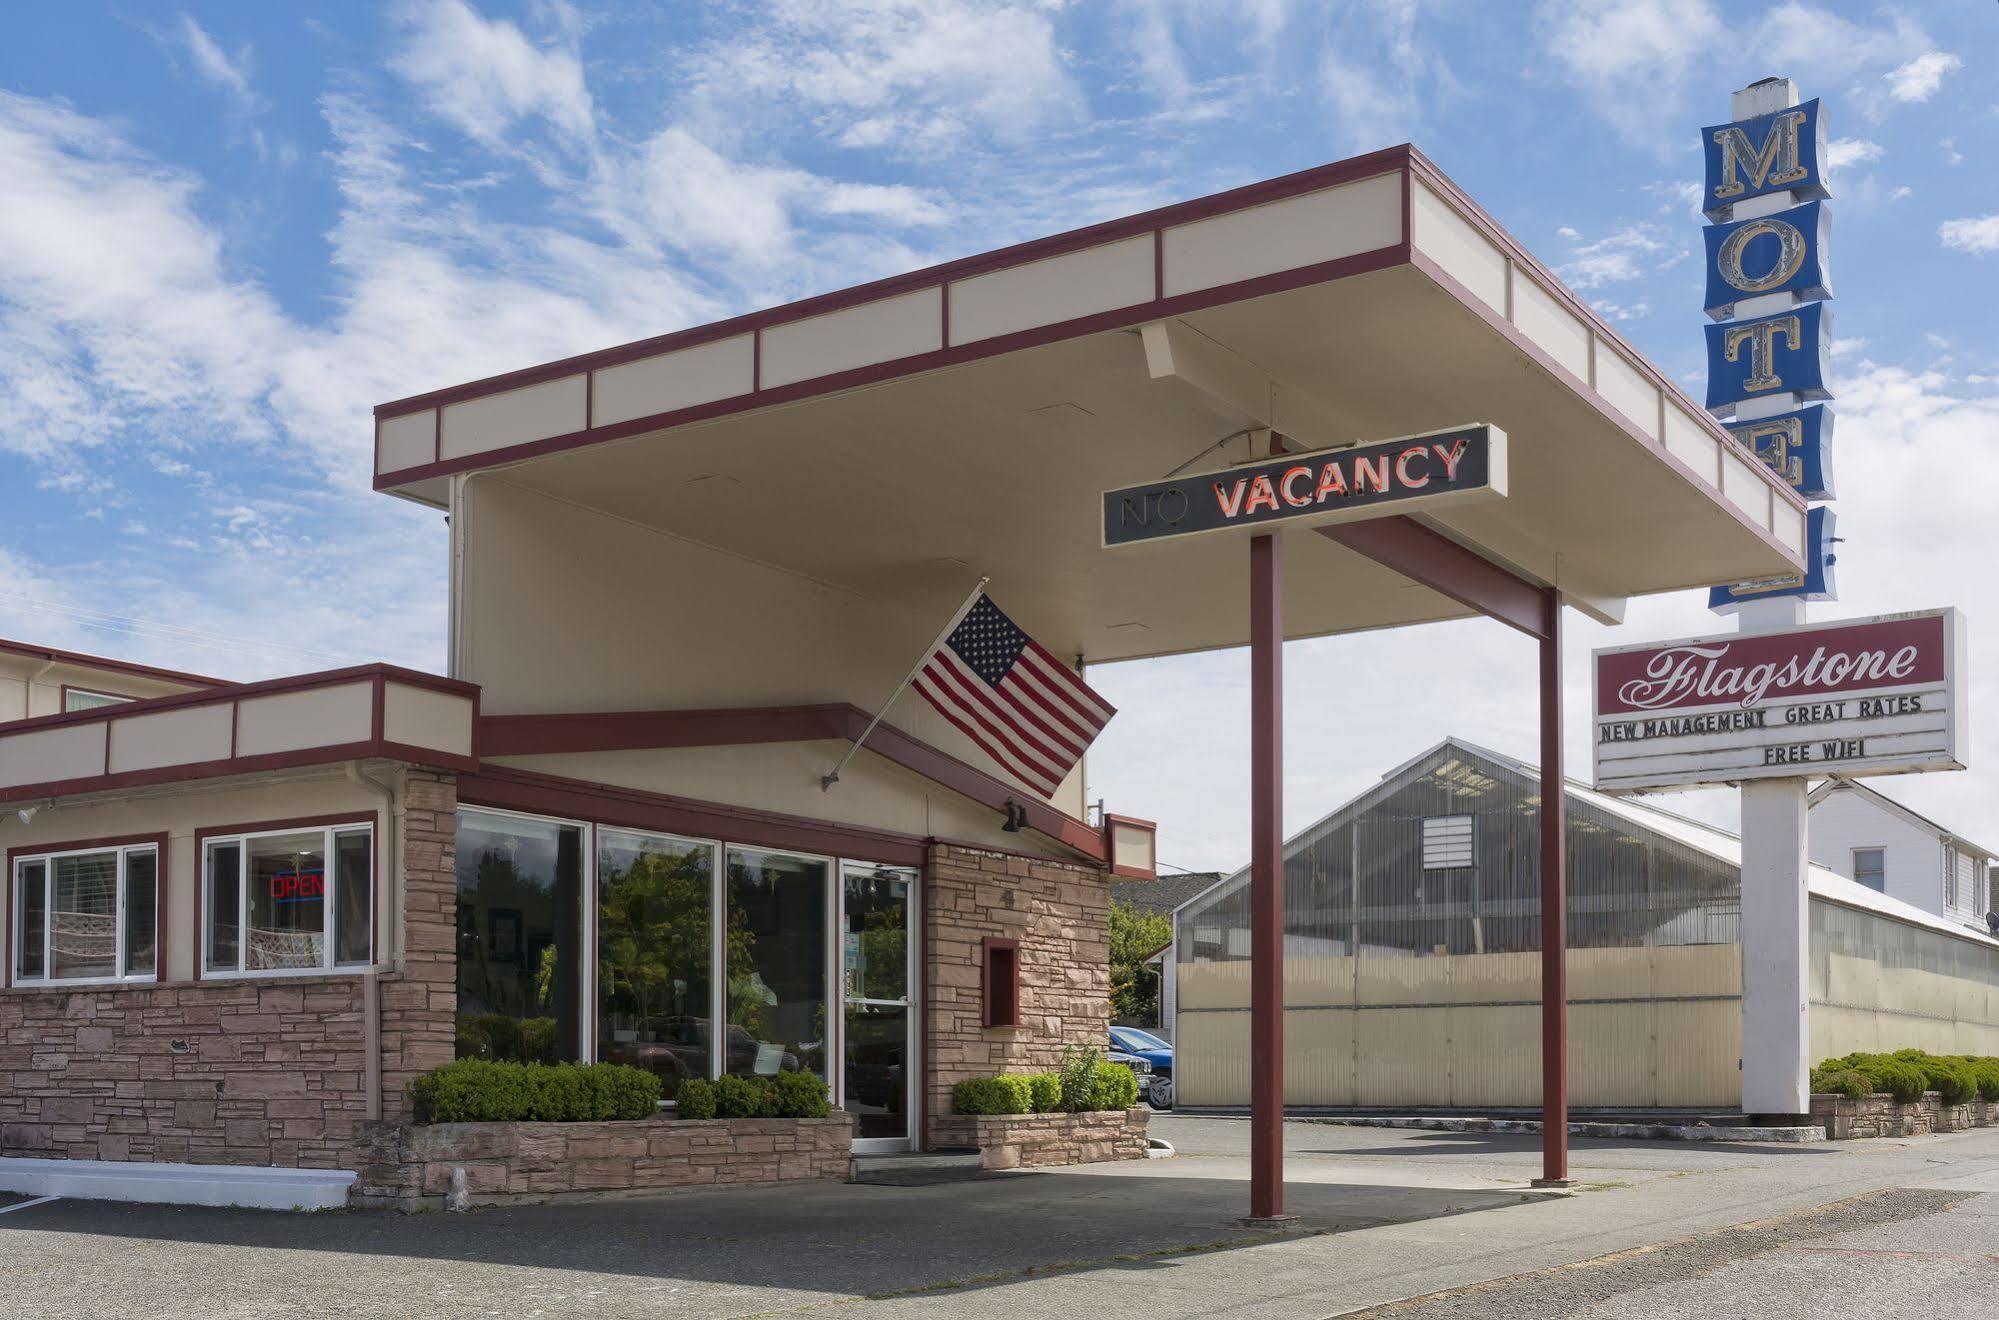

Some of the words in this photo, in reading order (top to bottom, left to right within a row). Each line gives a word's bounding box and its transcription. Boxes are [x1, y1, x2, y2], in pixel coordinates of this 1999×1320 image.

[1713, 110, 1808, 596] MOTE
[1120, 487, 1190, 528] NO
[1213, 438, 1473, 519] VACANCY
[1618, 642, 1918, 709] Flagstone
[1601, 722, 1637, 742] NEW
[1644, 710, 1767, 738] MANAGEMENT
[1785, 702, 1846, 724] GREAT
[1859, 695, 1921, 718] RATES
[1764, 745, 1810, 766] FREE
[1822, 739, 1865, 760] WIFI
[271, 874, 325, 898] OPEN
